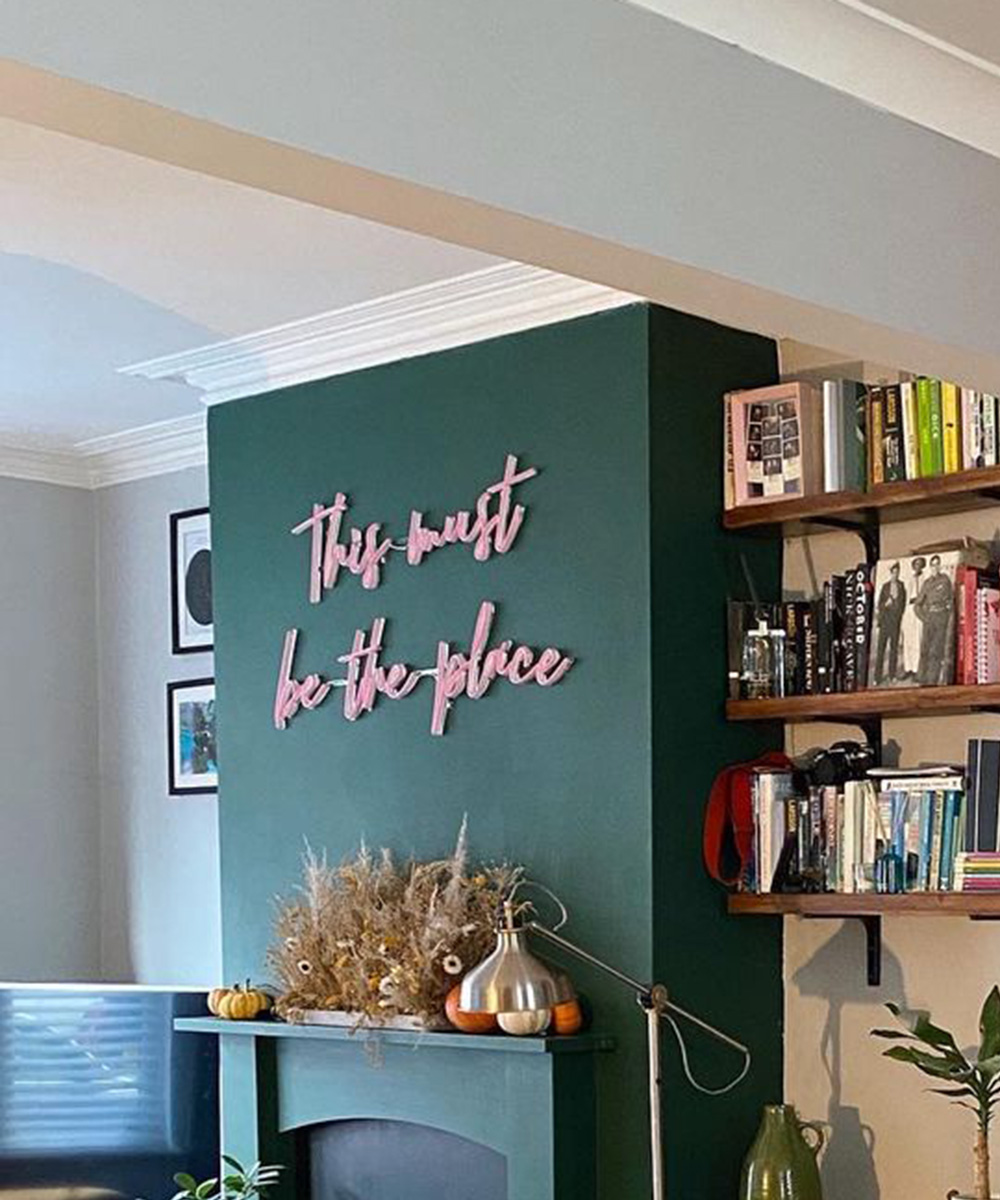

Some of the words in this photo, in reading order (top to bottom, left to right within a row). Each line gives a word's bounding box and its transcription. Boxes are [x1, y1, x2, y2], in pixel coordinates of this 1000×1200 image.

[291, 492, 392, 604] This
[405, 453, 538, 566] must
[274, 628, 331, 729] be
[336, 616, 419, 722] the
[430, 600, 572, 735] place
